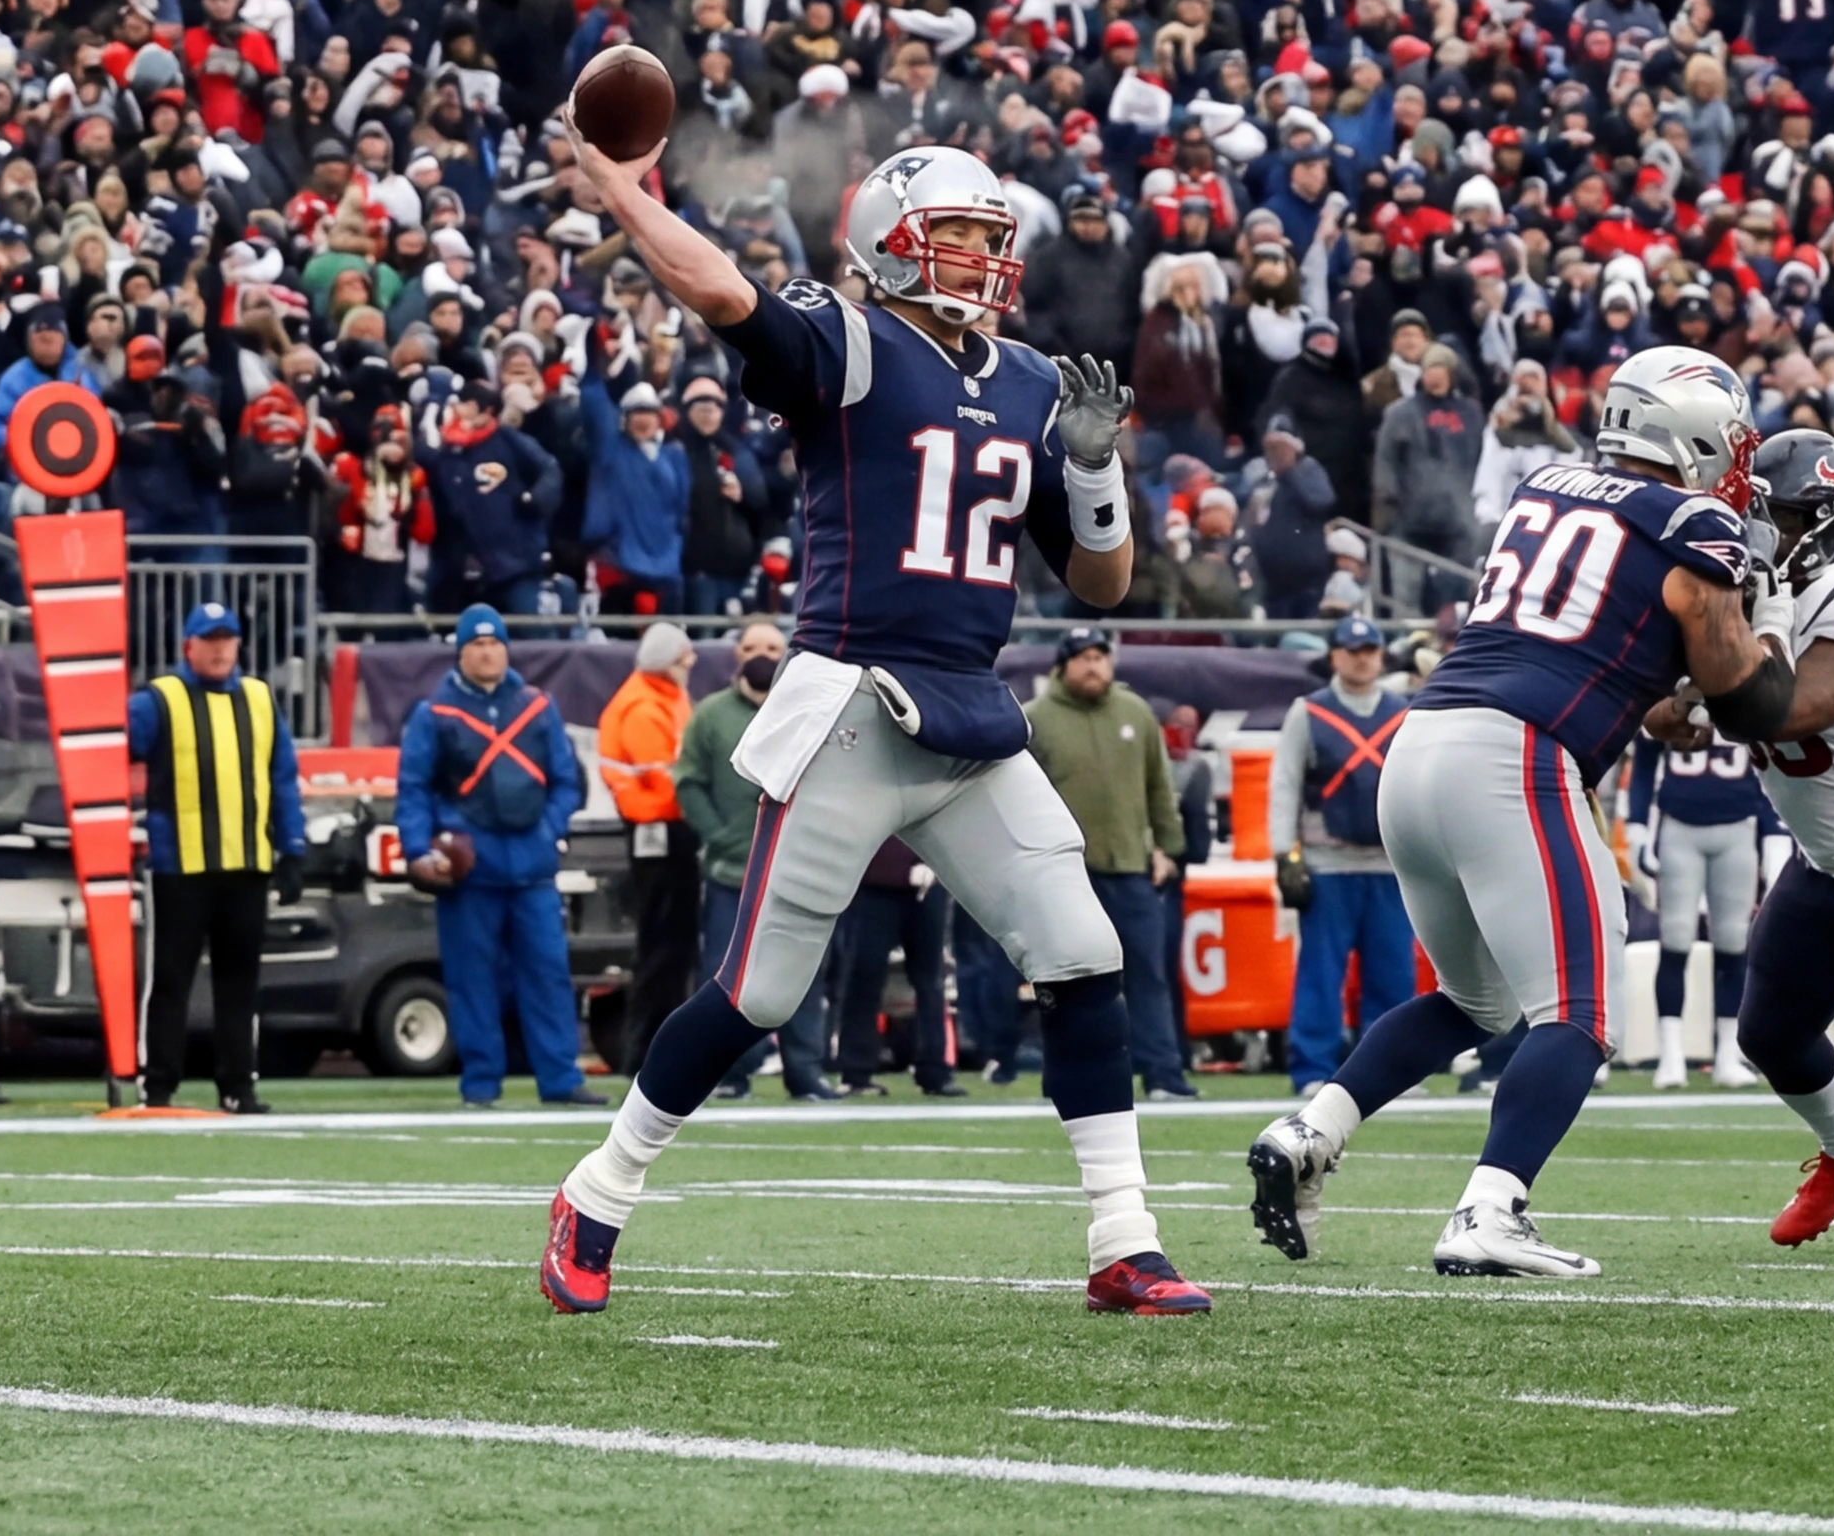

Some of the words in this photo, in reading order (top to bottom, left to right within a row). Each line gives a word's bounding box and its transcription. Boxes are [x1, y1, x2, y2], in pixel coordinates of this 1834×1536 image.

[898, 425, 1034, 587] 12
[1466, 498, 1629, 643] 60
[1182, 908, 1227, 996] G
